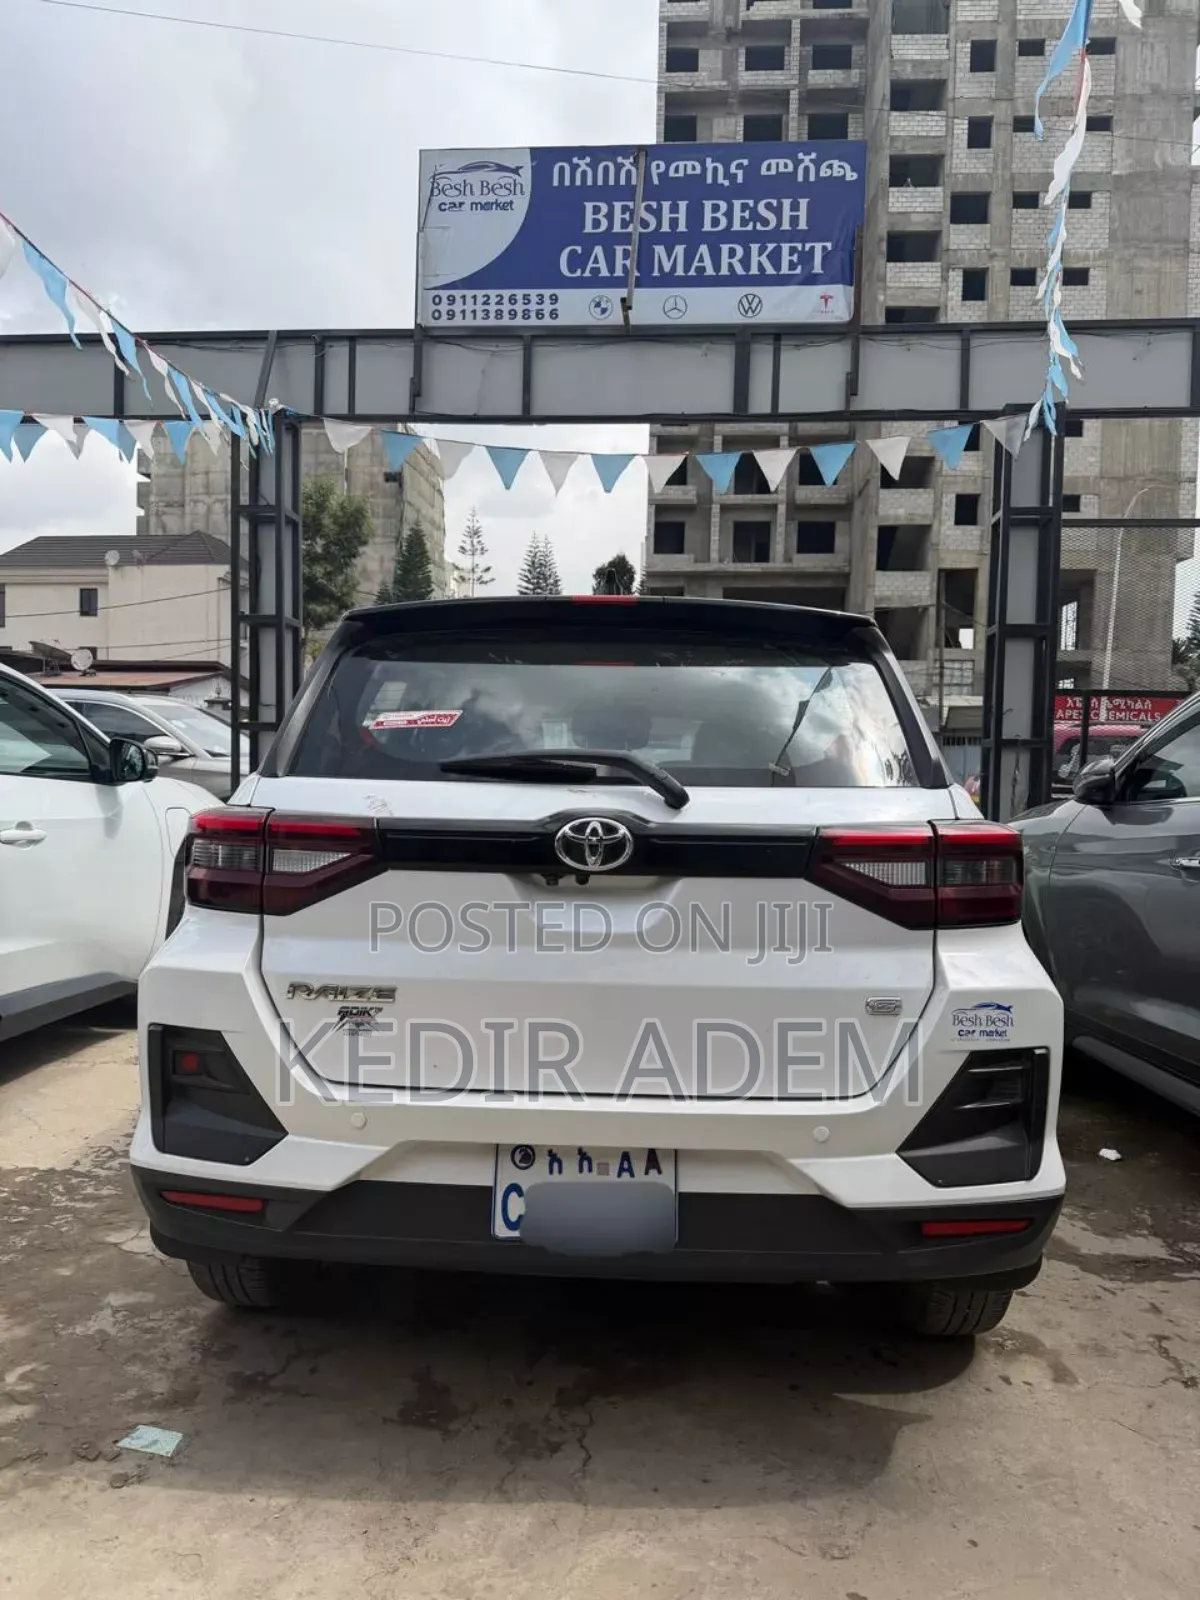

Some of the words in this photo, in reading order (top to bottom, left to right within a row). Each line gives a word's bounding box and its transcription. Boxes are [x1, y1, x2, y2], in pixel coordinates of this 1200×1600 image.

[650, 157, 749, 187] የመኪና
[431, 179, 475, 197] Besh
[480, 179, 525, 197] Besh
[438, 201, 465, 212] car
[470, 199, 514, 212] market
[582, 200, 689, 233] BESH
[701, 198, 811, 232] BESH
[559, 245, 640, 277] CAR
[652, 242, 832, 276] MARKET
[431, 293, 559, 306] 0911226539
[431, 308, 559, 321] 0911389866
[1056, 709, 1085, 720] APE
[1090, 710, 1161, 722] CEMICALS
[952, 1013, 982, 1027] Besh
[985, 1013, 1014, 1028] Besh
[958, 1029, 976, 1037] car
[979, 1029, 1007, 1037] market
